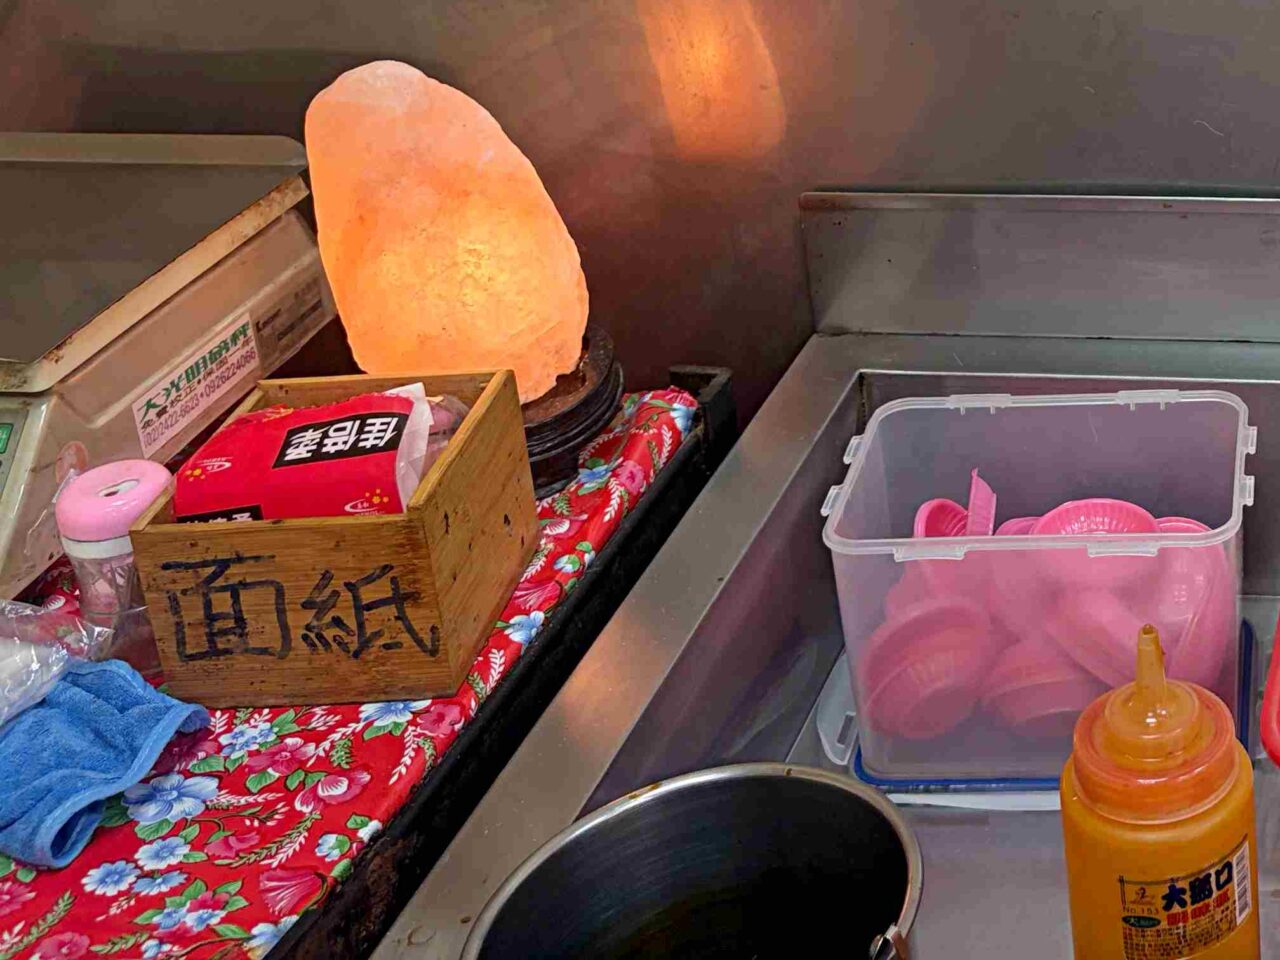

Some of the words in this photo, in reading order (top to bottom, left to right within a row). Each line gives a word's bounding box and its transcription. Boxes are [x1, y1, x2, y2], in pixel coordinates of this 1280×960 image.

[284, 416, 399, 461] 佳倍柔
[159, 553, 441, 661] 面紙
